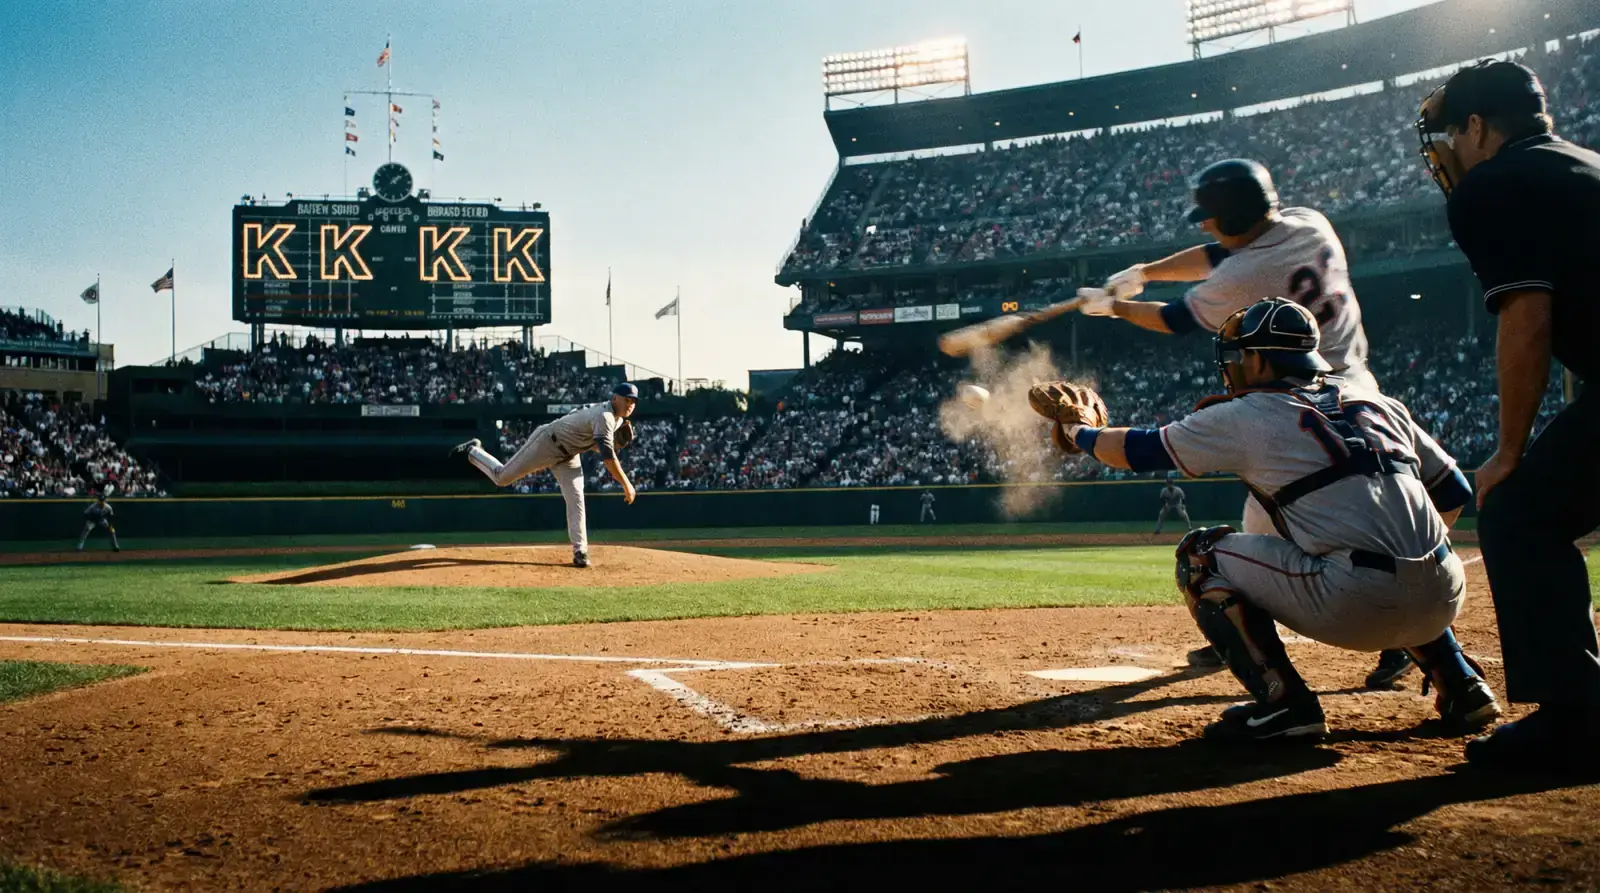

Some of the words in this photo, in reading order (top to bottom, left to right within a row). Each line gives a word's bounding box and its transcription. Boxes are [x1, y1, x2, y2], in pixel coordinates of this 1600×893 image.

[243, 223, 297, 279] K
[320, 224, 373, 281] K
[419, 226, 472, 282] K
[493, 227, 545, 283] K
